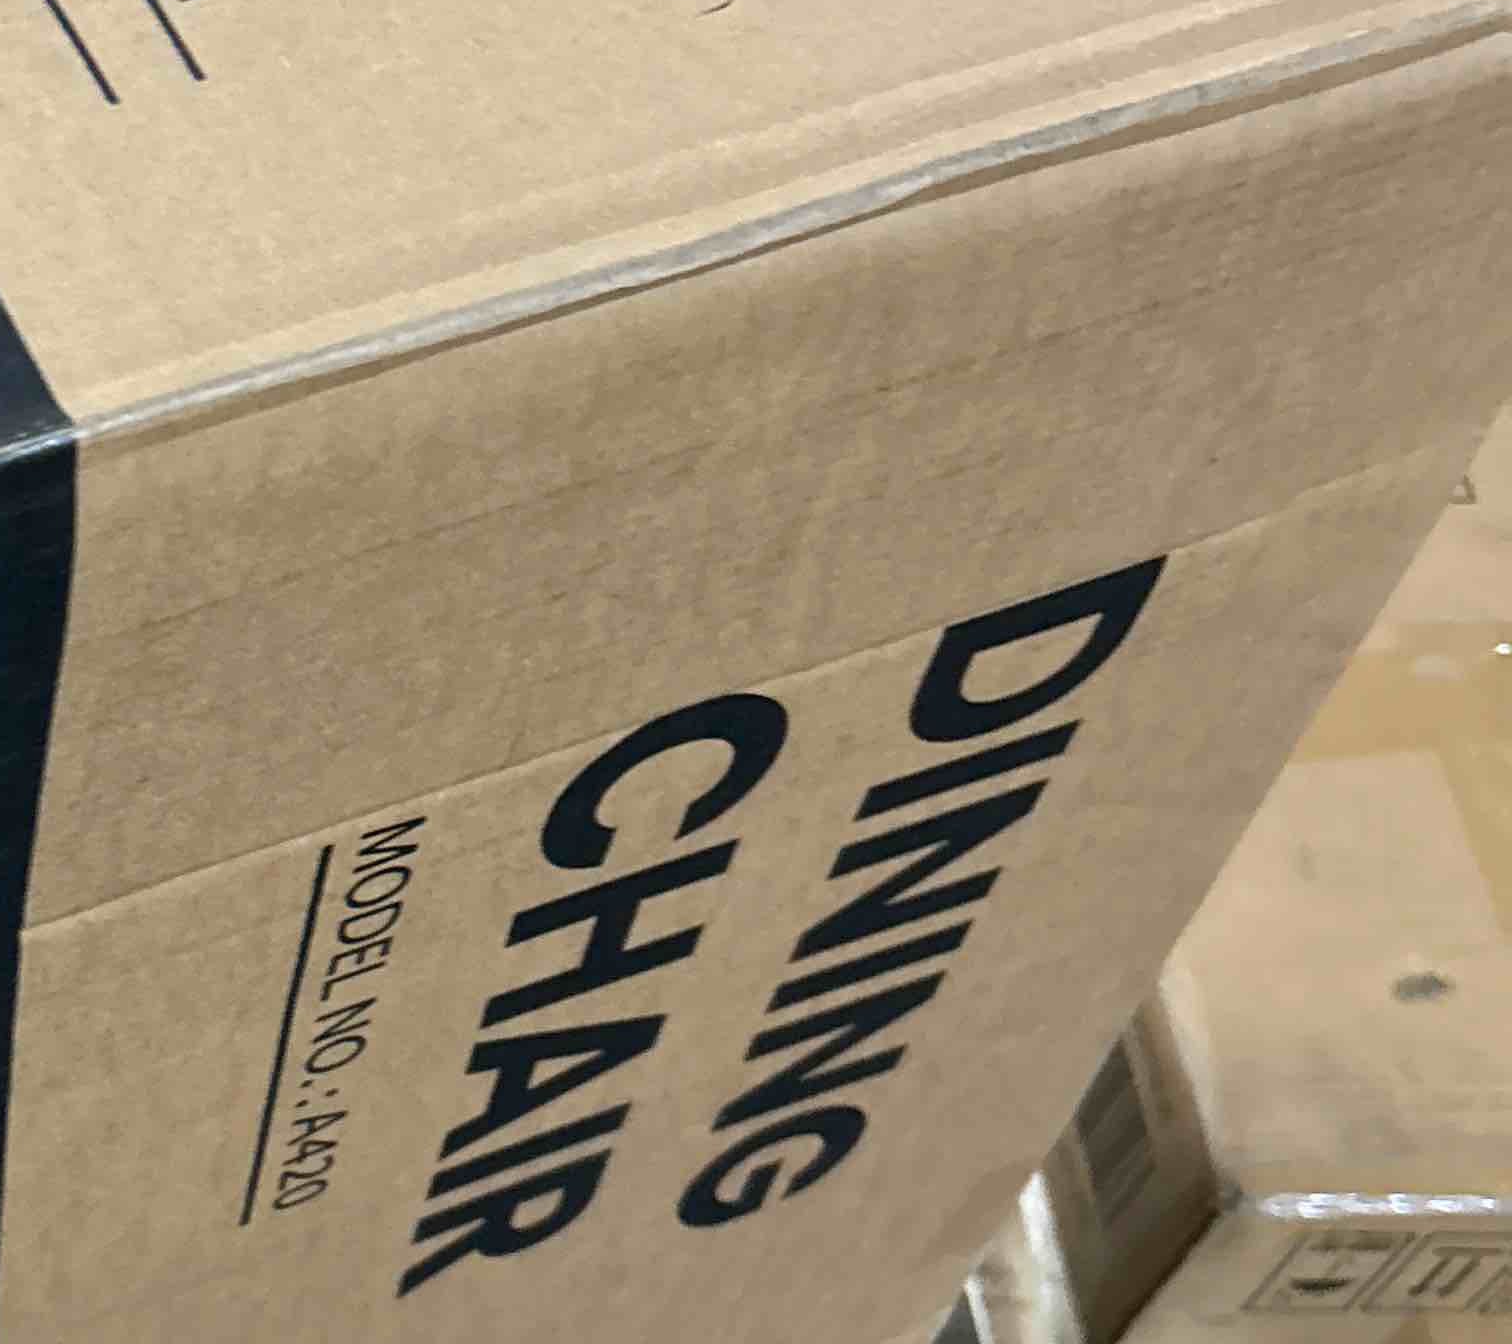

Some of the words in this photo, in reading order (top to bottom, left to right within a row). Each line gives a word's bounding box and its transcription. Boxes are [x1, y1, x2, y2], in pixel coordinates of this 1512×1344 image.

[320, 815, 428, 1002] MODEL
[396, 692, 792, 1300] CHAIR
[675, 553, 1168, 1229] DINING
